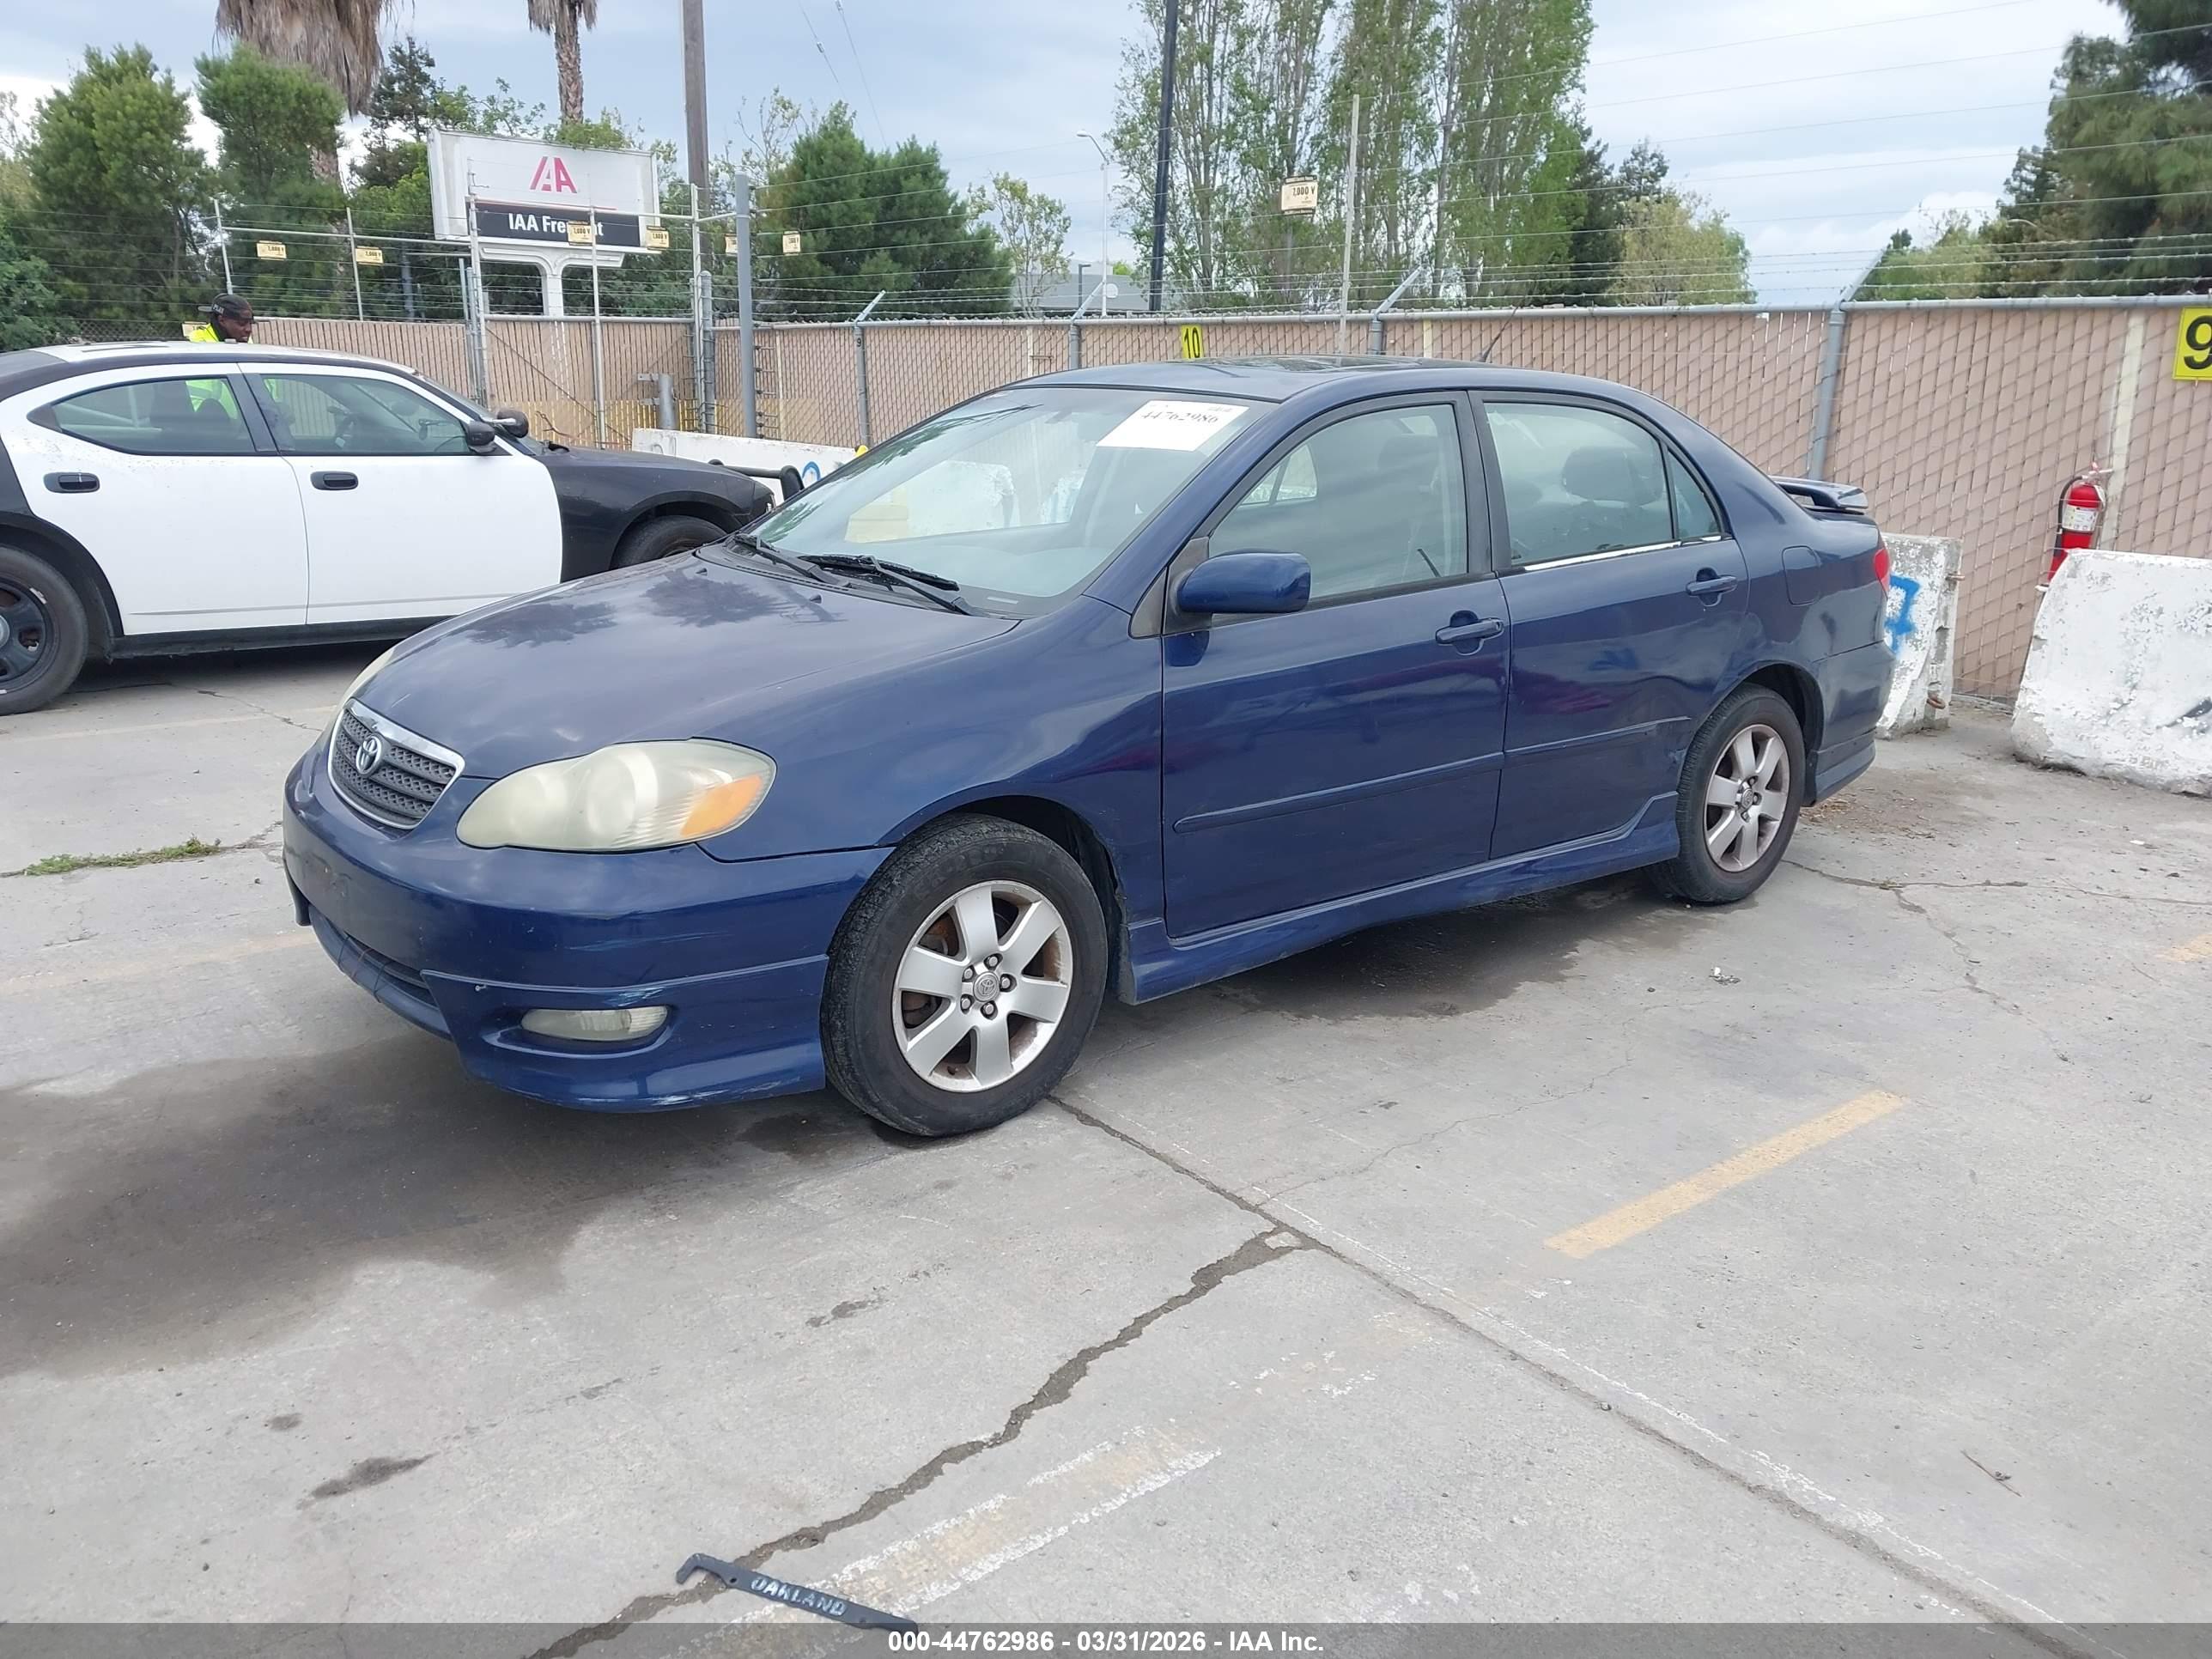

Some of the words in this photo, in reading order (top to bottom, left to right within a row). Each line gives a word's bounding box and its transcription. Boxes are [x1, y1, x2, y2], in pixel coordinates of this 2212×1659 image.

[508, 212, 539, 232] IAA
[542, 215, 604, 236] Fret
[1184, 327, 1200, 359] 10
[2184, 315, 2212, 370] 9
[750, 1577, 847, 1616] OAKLAND
